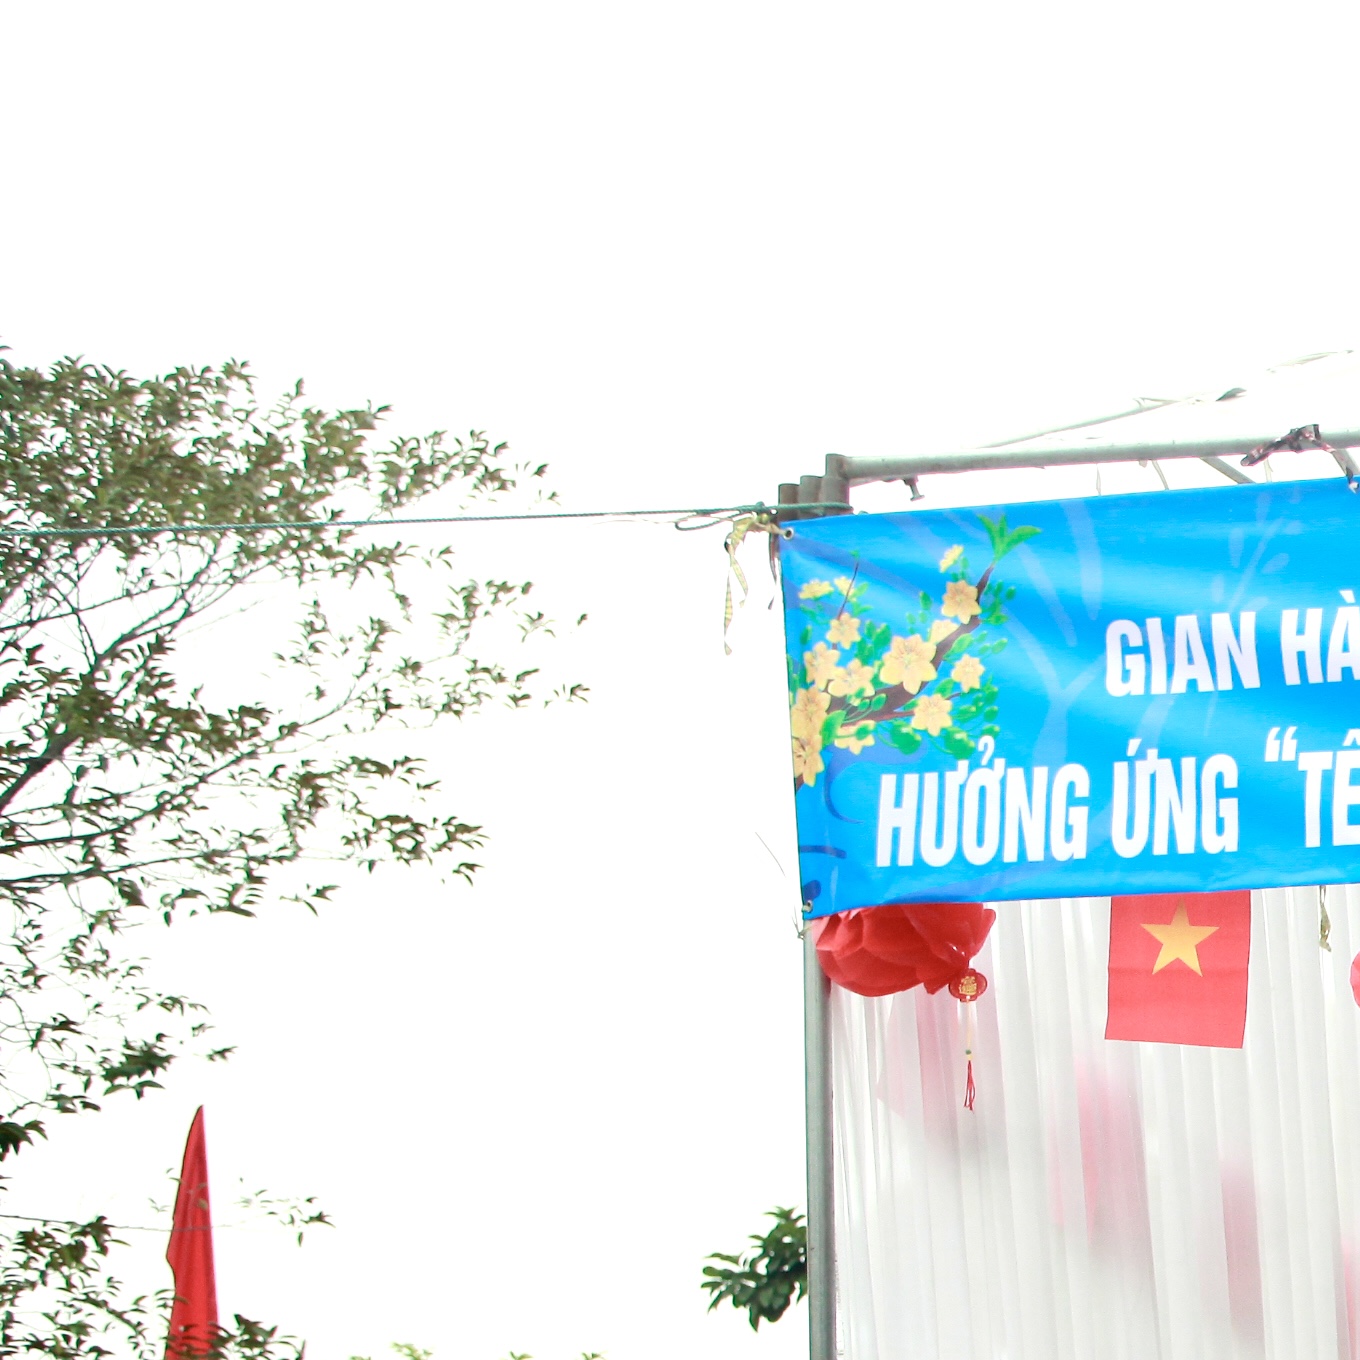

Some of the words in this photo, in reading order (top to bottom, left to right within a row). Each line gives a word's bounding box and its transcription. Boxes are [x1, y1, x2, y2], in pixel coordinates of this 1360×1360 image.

[1106, 611, 1259, 697] GIAN
[877, 734, 1089, 867] HƯỞNG
[1112, 738, 1238, 857] ỨNG
